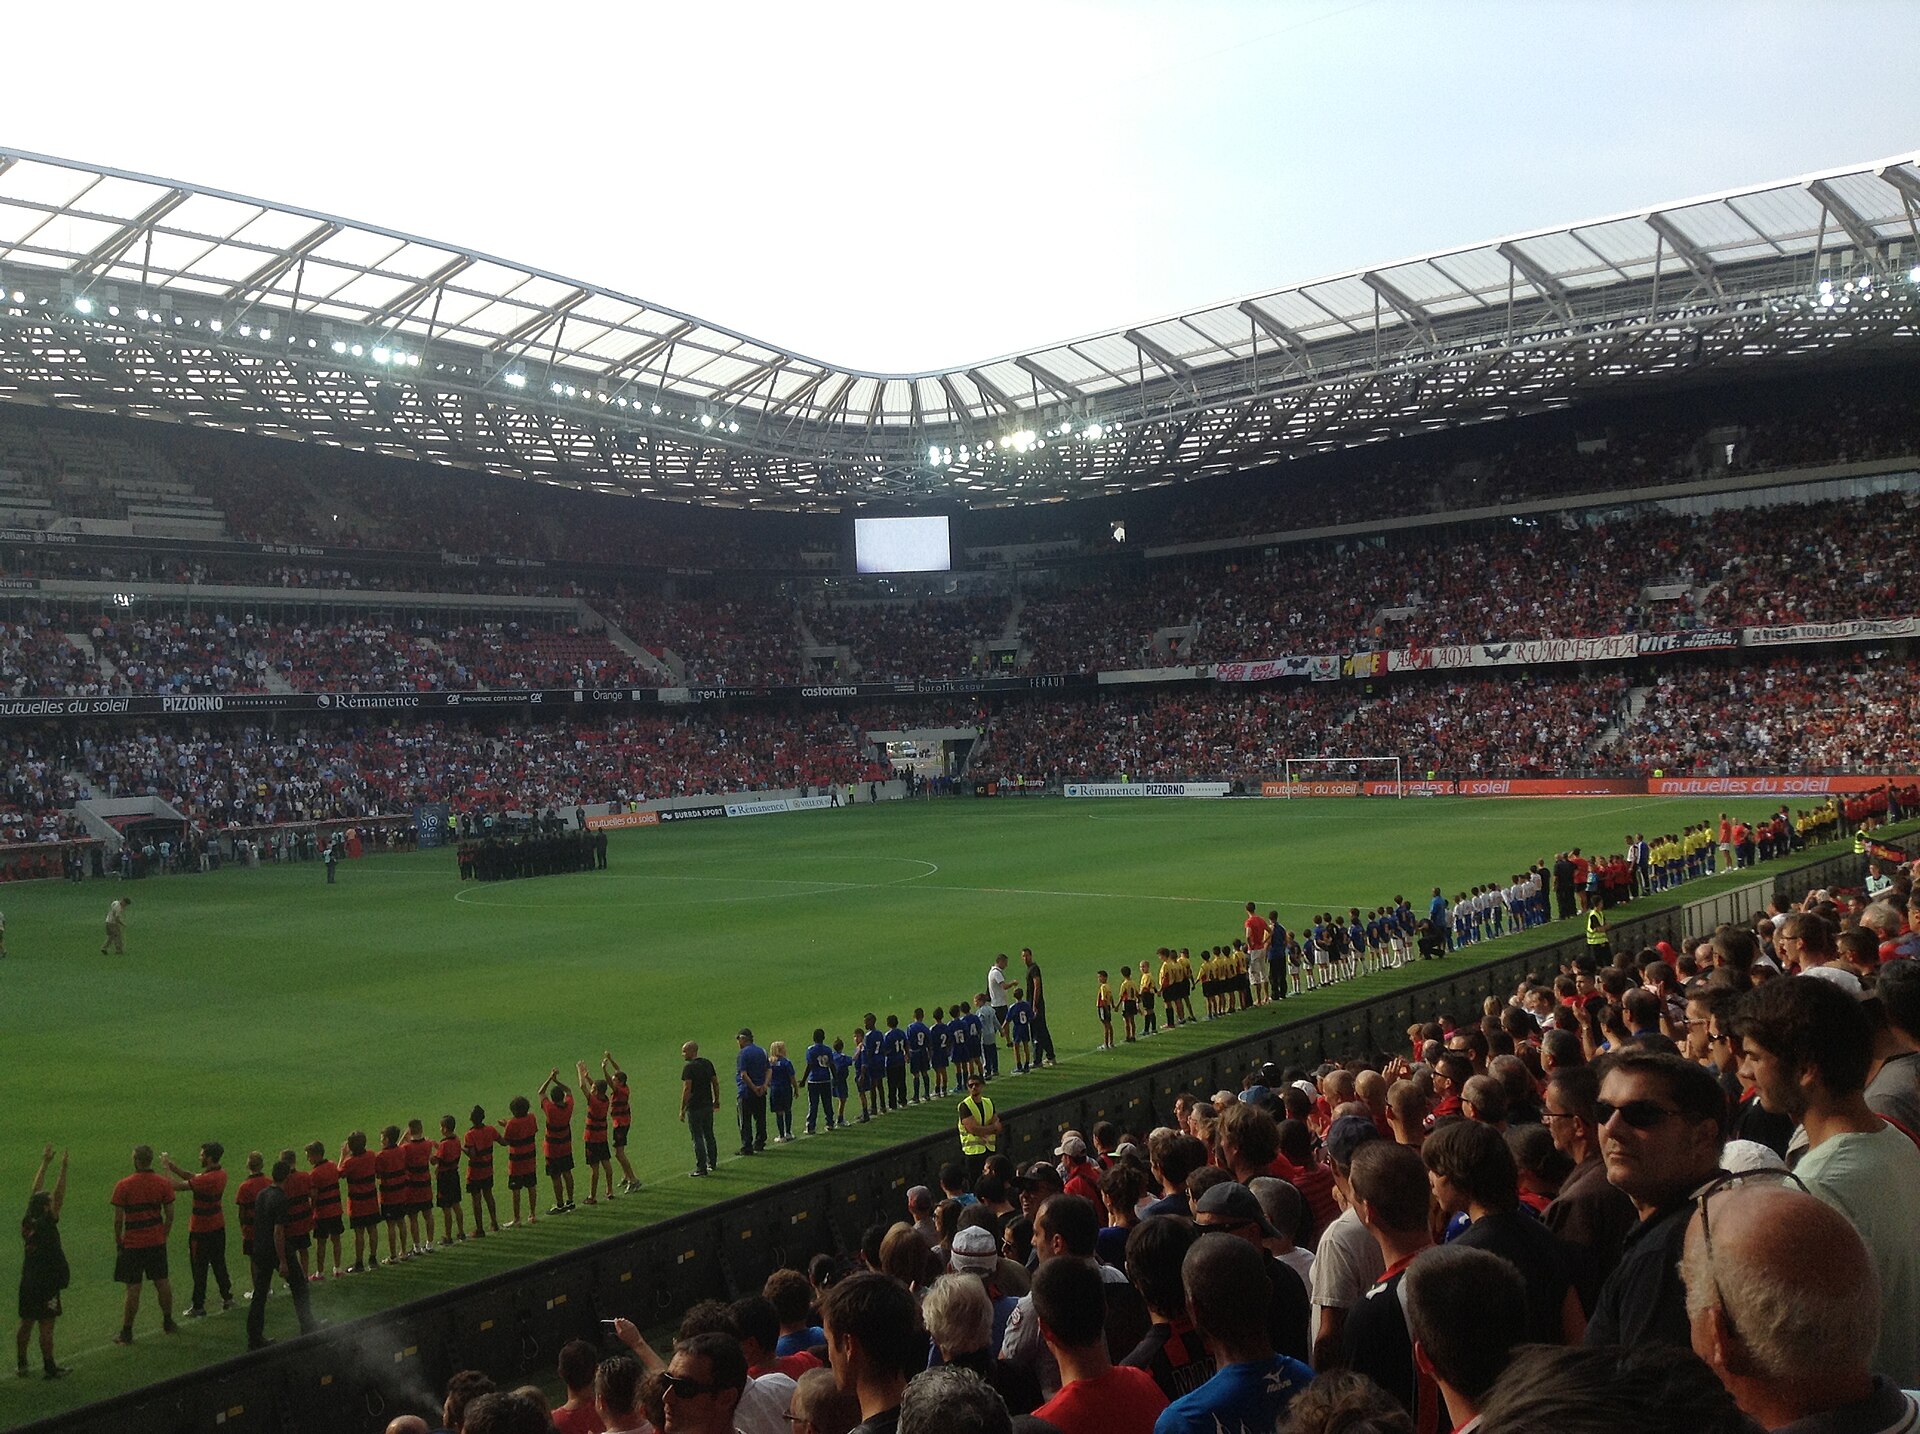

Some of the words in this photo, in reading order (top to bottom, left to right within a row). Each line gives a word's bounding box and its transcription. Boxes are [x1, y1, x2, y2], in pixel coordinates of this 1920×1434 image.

[47, 533, 76, 543] Riviera
[592, 690, 623, 702] Orange
[801, 686, 857, 697] castorama
[68, 700, 89, 713] du
[92, 699, 129, 712] soleil
[162, 696, 224, 711] PIZZORNO
[335, 694, 419, 708] Rémanence
[1080, 785, 1141, 796] Rémanence
[1146, 784, 1185, 795] PIZZORNO
[1314, 784, 1328, 794] du
[1331, 784, 1357, 794] soleil
[1373, 781, 1444, 795] muelles
[1472, 780, 1511, 794] soleil
[1661, 778, 1747, 793] mutuelles
[1751, 777, 1777, 792] du
[1782, 777, 1829, 792] soleil
[702, 808, 723, 817] SPORT
[738, 802, 784, 815] Rémanence
[588, 816, 625, 828] mutuelles
[626, 815, 638, 825] du
[639, 814, 657, 824] soleil
[1019, 1010, 1028, 1025] 6
[917, 1031, 926, 1046] 9
[940, 1033, 948, 1048] 2
